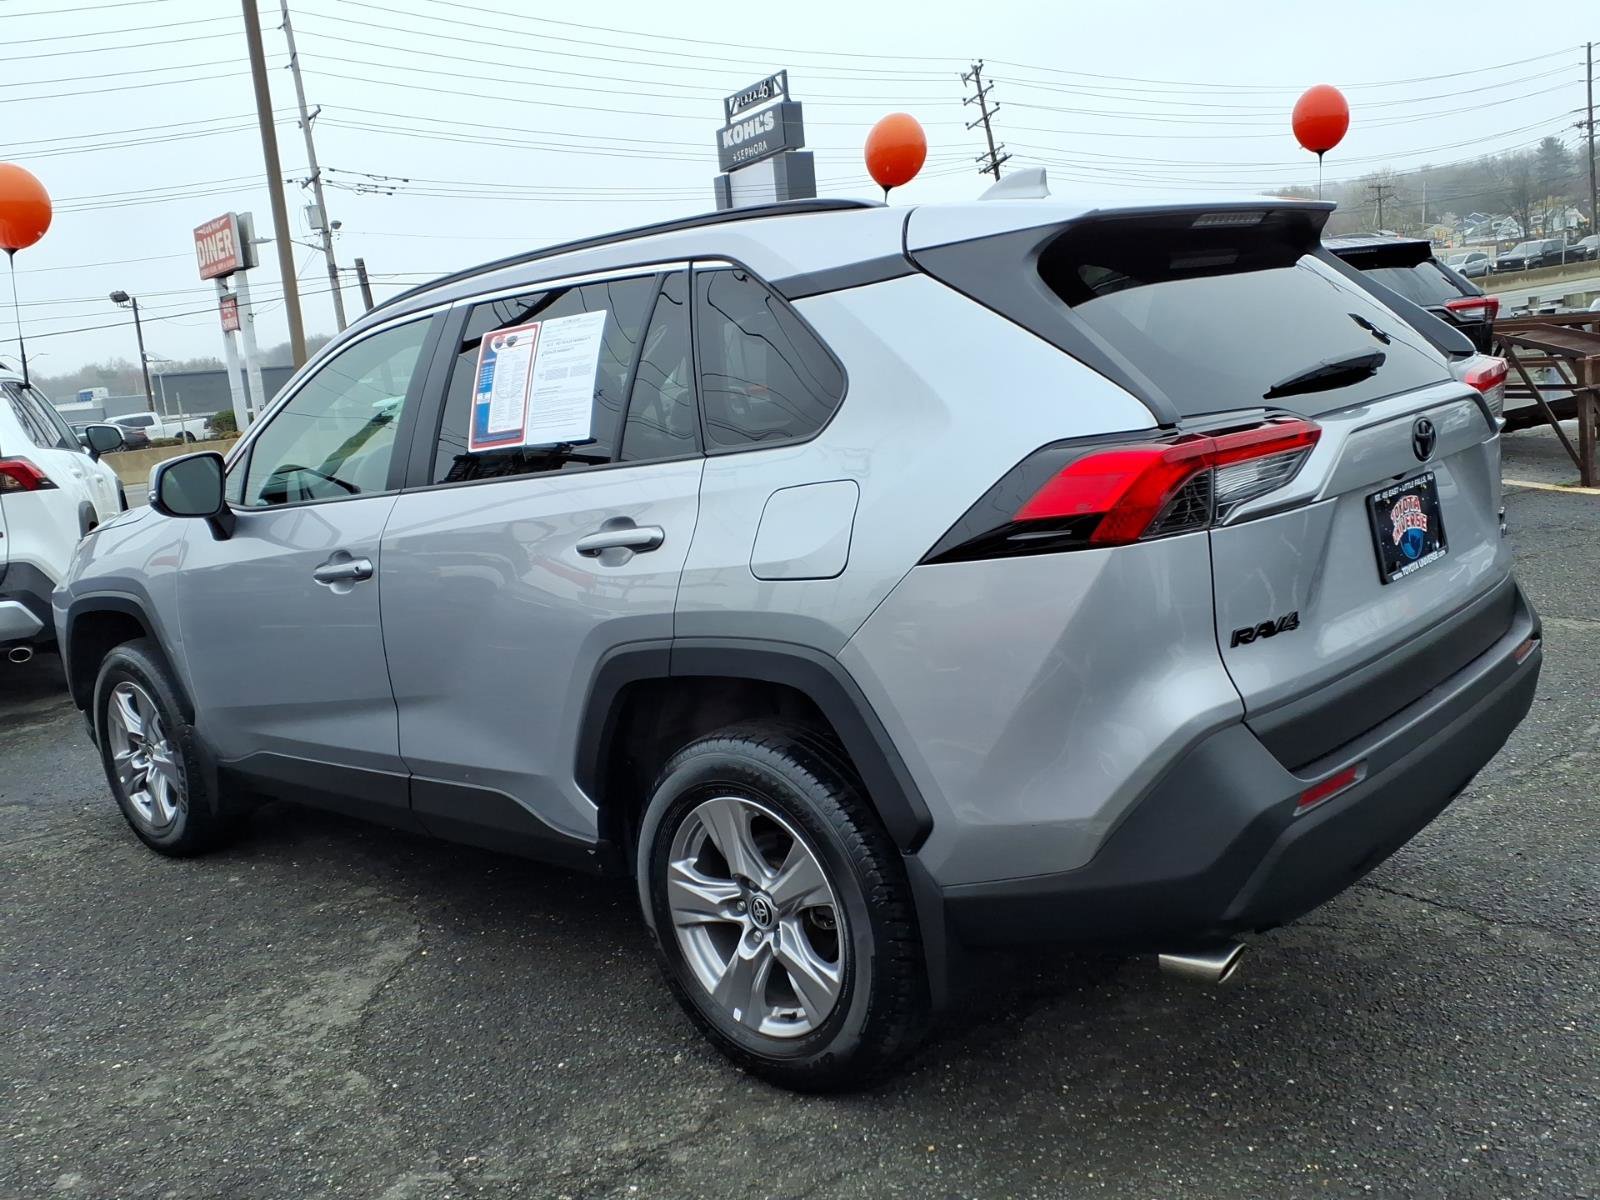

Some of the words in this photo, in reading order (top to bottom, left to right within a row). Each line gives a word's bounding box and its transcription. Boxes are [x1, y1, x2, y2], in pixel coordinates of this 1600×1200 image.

[736, 89, 757, 106] PLAZA
[758, 81, 769, 99] 46
[722, 110, 775, 149] KOHL'S
[196, 228, 234, 268] DINER
[1230, 610, 1300, 648] RAV4
